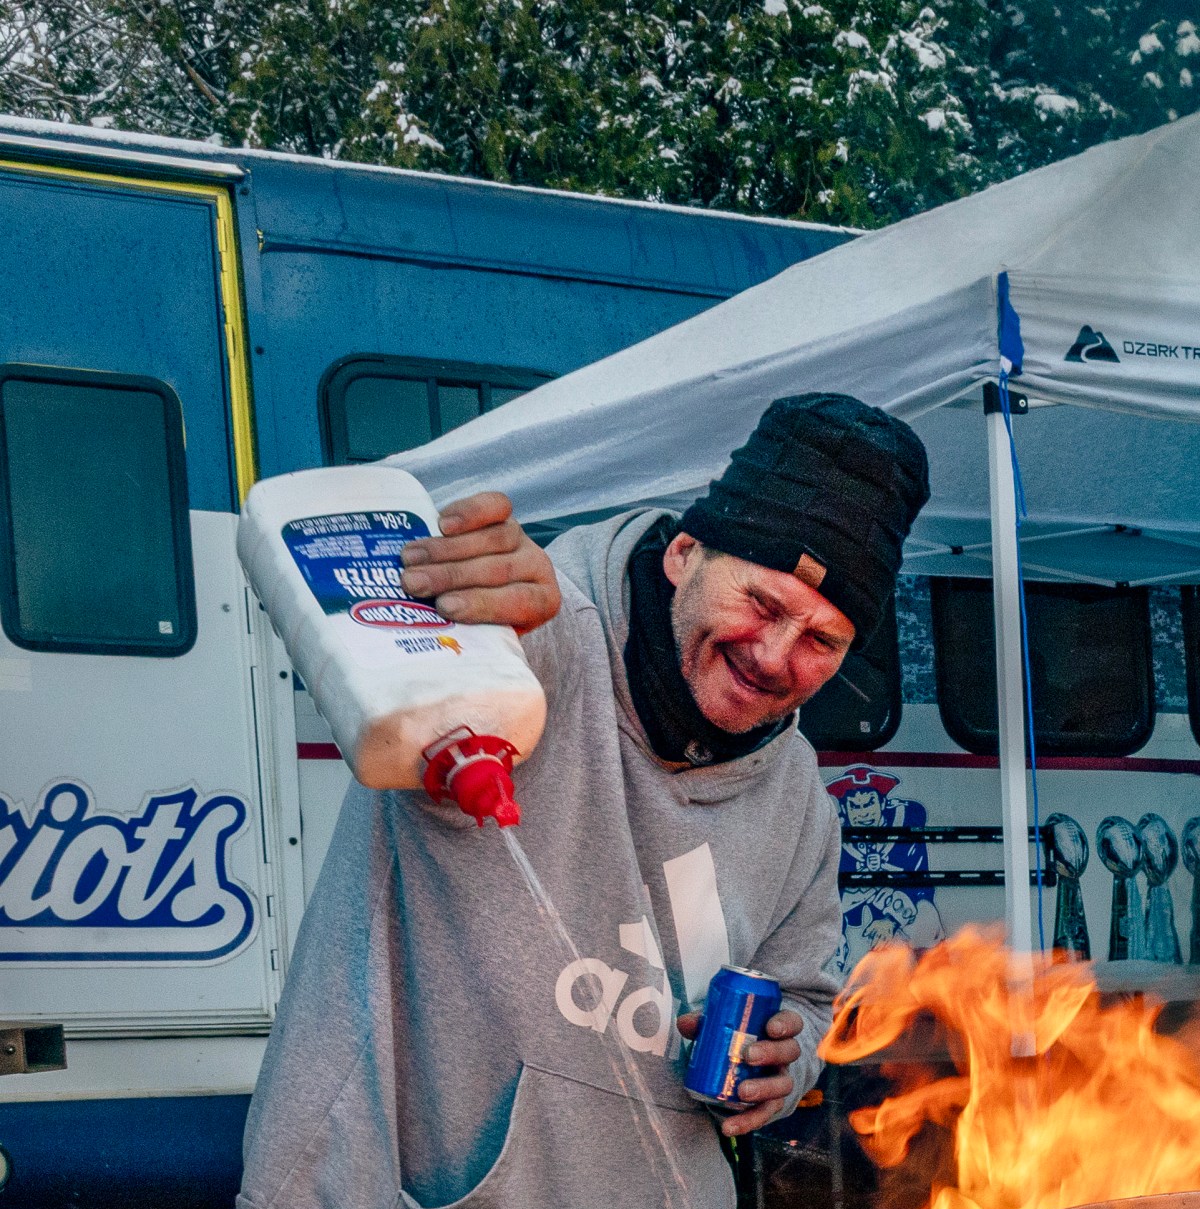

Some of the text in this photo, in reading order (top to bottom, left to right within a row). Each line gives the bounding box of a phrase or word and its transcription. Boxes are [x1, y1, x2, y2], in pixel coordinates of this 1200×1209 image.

[1123, 341, 1179, 359] OZARK
[333, 568, 404, 587] GHTER
[343, 585, 414, 600] ARCOAL
